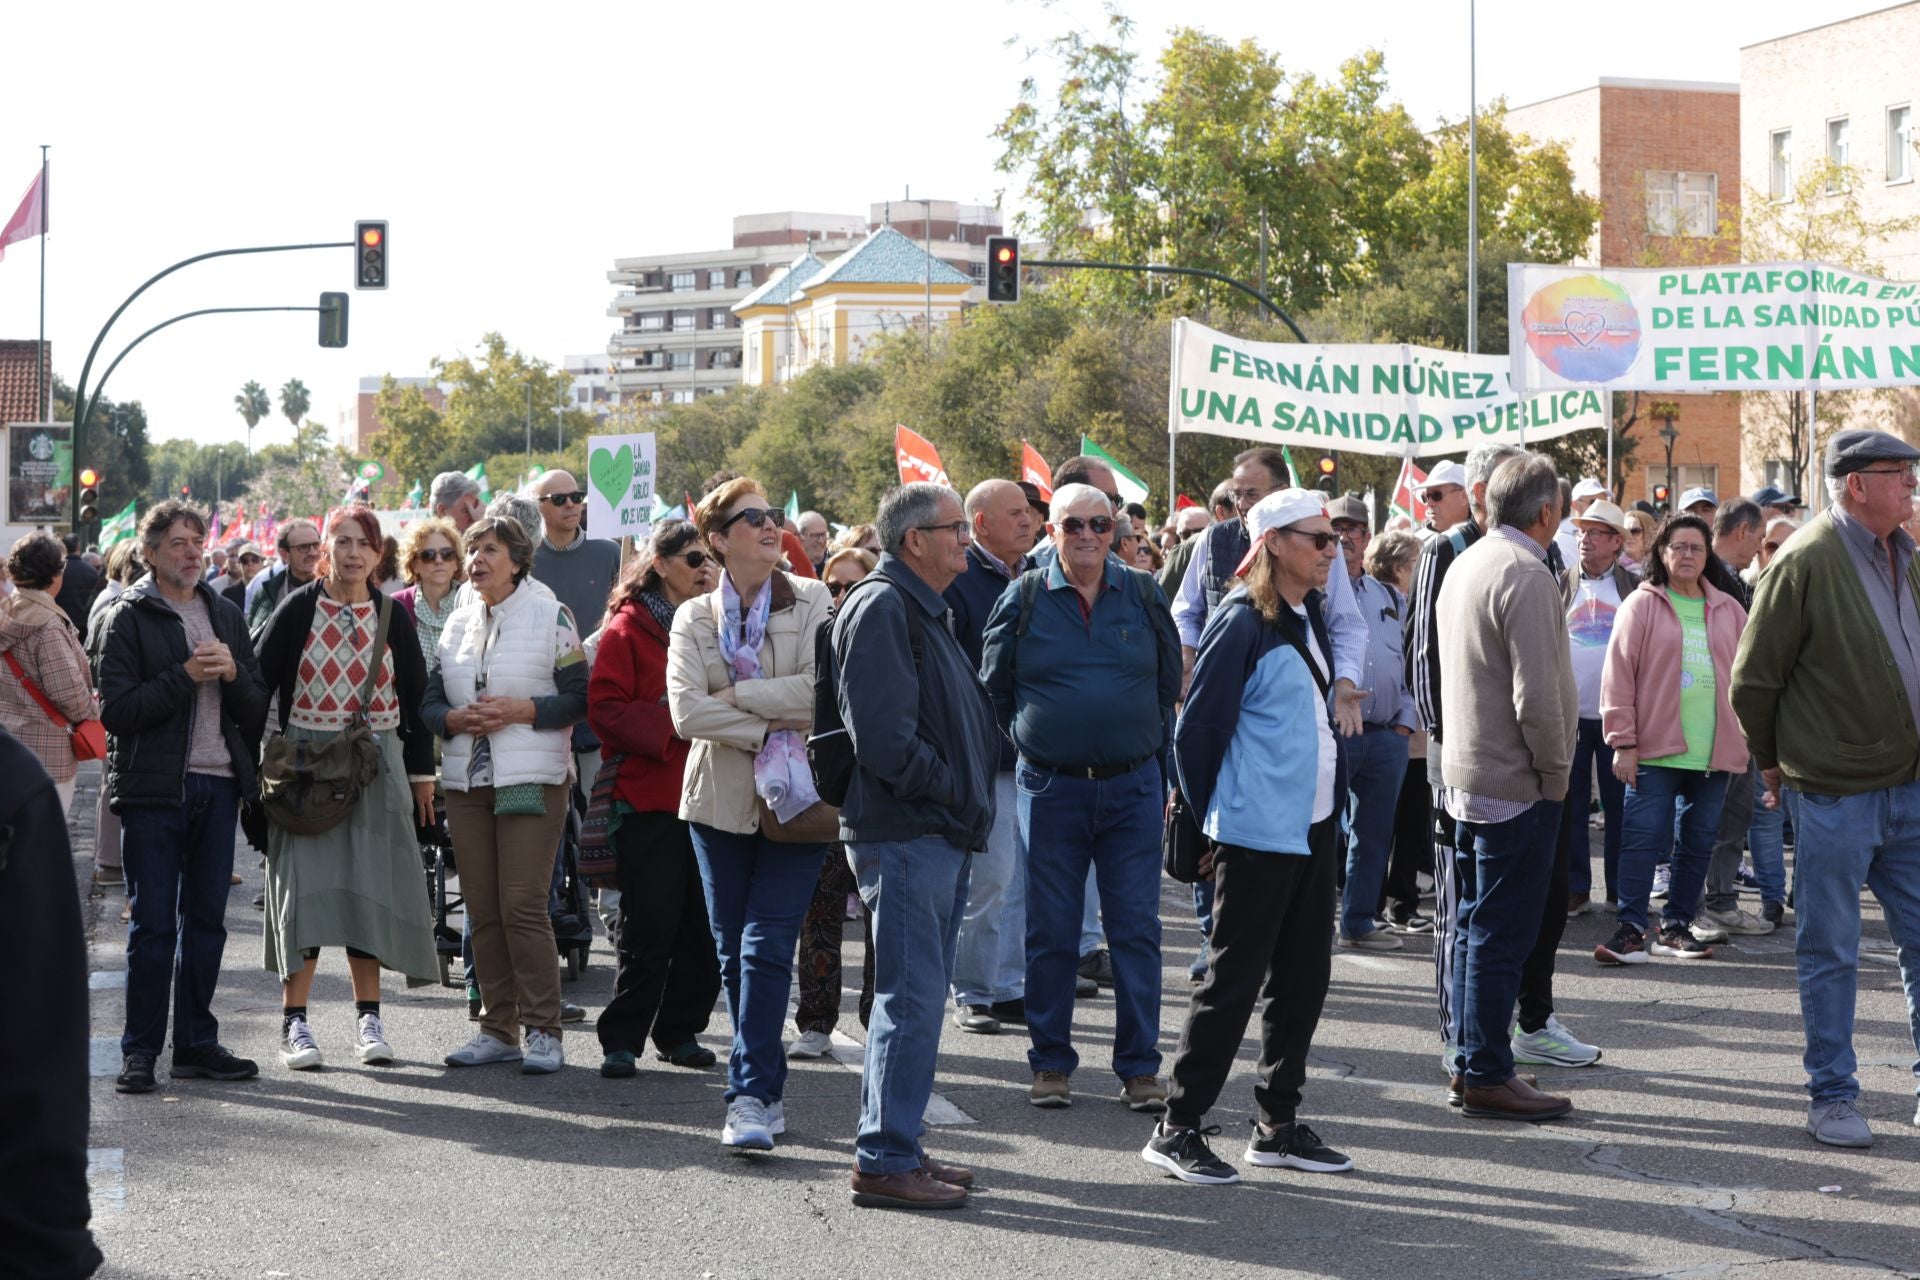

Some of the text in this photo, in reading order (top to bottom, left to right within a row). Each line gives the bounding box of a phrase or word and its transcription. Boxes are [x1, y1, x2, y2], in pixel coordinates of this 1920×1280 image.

[1659, 269, 1917, 300] PLATAFORMA EN
[1652, 306, 1694, 329] DE
[1703, 305, 1745, 328] LA
[1753, 304, 1881, 329] SANIDAD
[1209, 344, 1498, 400] FERNÁN NÚÑEZ
[1654, 333, 1878, 381] FERNÁN
[1180, 387, 1602, 443] UNA SANIDAD PÚBLICA
[633, 442, 642, 459] LA
[621, 508, 629, 525] NO
